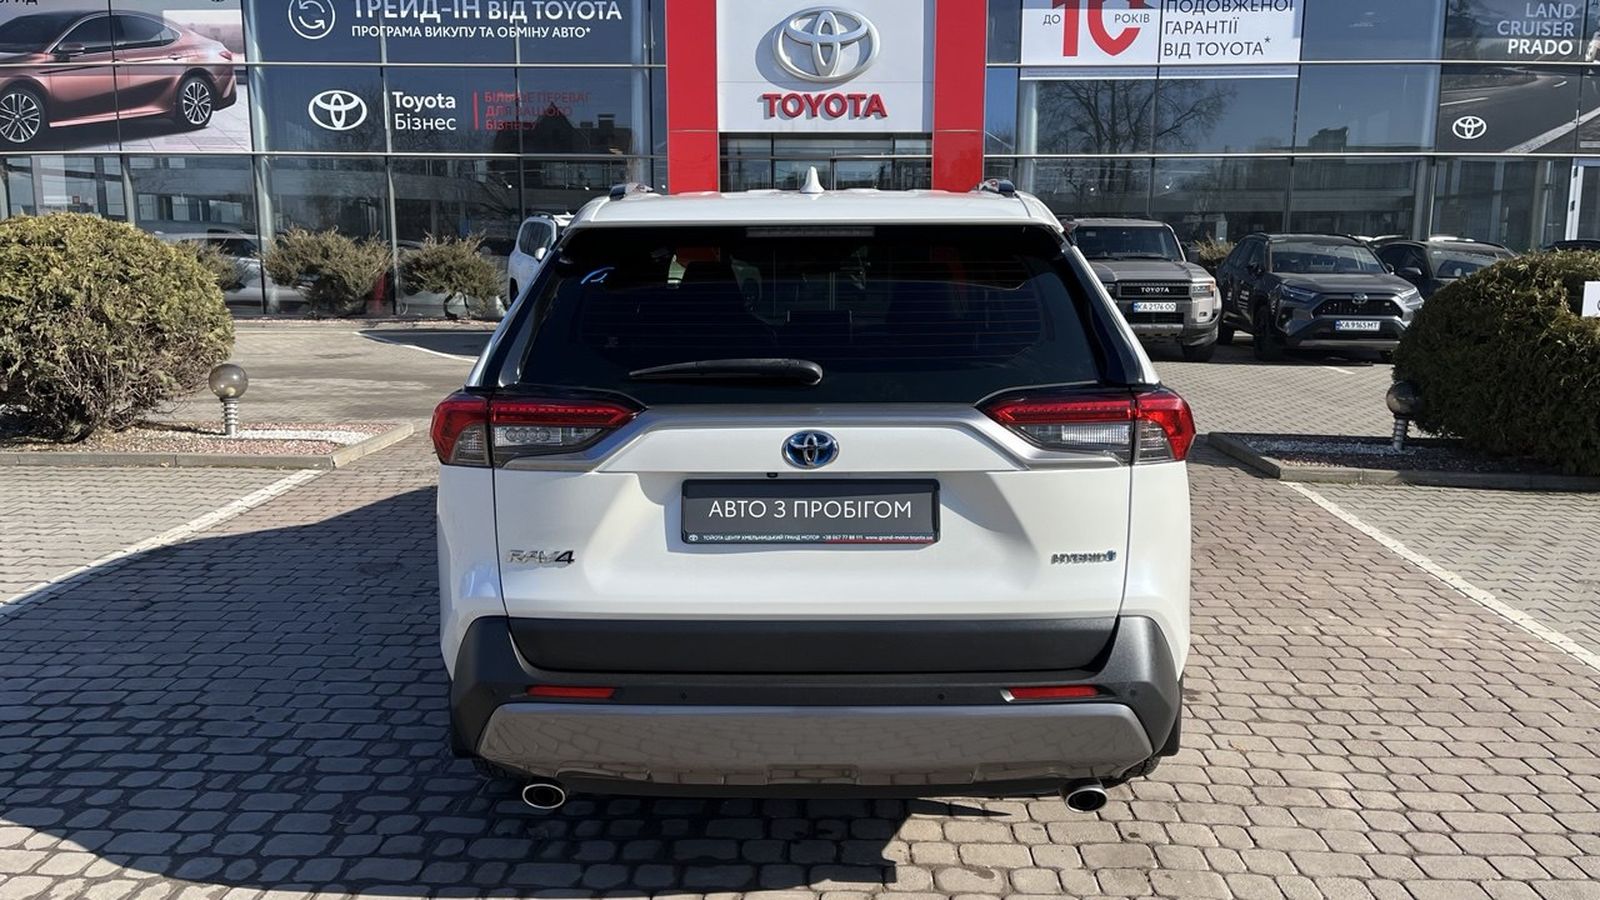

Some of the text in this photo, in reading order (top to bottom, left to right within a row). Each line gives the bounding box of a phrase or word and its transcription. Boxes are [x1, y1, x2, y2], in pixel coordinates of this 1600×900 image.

[488, 1, 528, 24] ВІД
[532, 1, 622, 20] TOYOTA
[1043, 14, 1060, 25] ДО
[1115, 13, 1150, 23] РОКІВ
[1526, 3, 1576, 18] LAND
[352, 26, 421, 37] ПРОГРАМА
[425, 26, 477, 38] ВИКУПУ
[479, 27, 495, 38] ТА
[497, 26, 550, 38] ОБМІНУ
[1165, 16, 1240, 35] ГАРАНТІЇ
[1497, 20, 1574, 36] CRUISER
[1163, 42, 1191, 59] ВІД
[1508, 39, 1573, 55] PRADO
[392, 91, 456, 113] Toyota
[761, 93, 888, 118] TOYOTA
[395, 113, 457, 131] Бізнес
[708, 500, 912, 519] АВТО З ПРОБІГОМ
